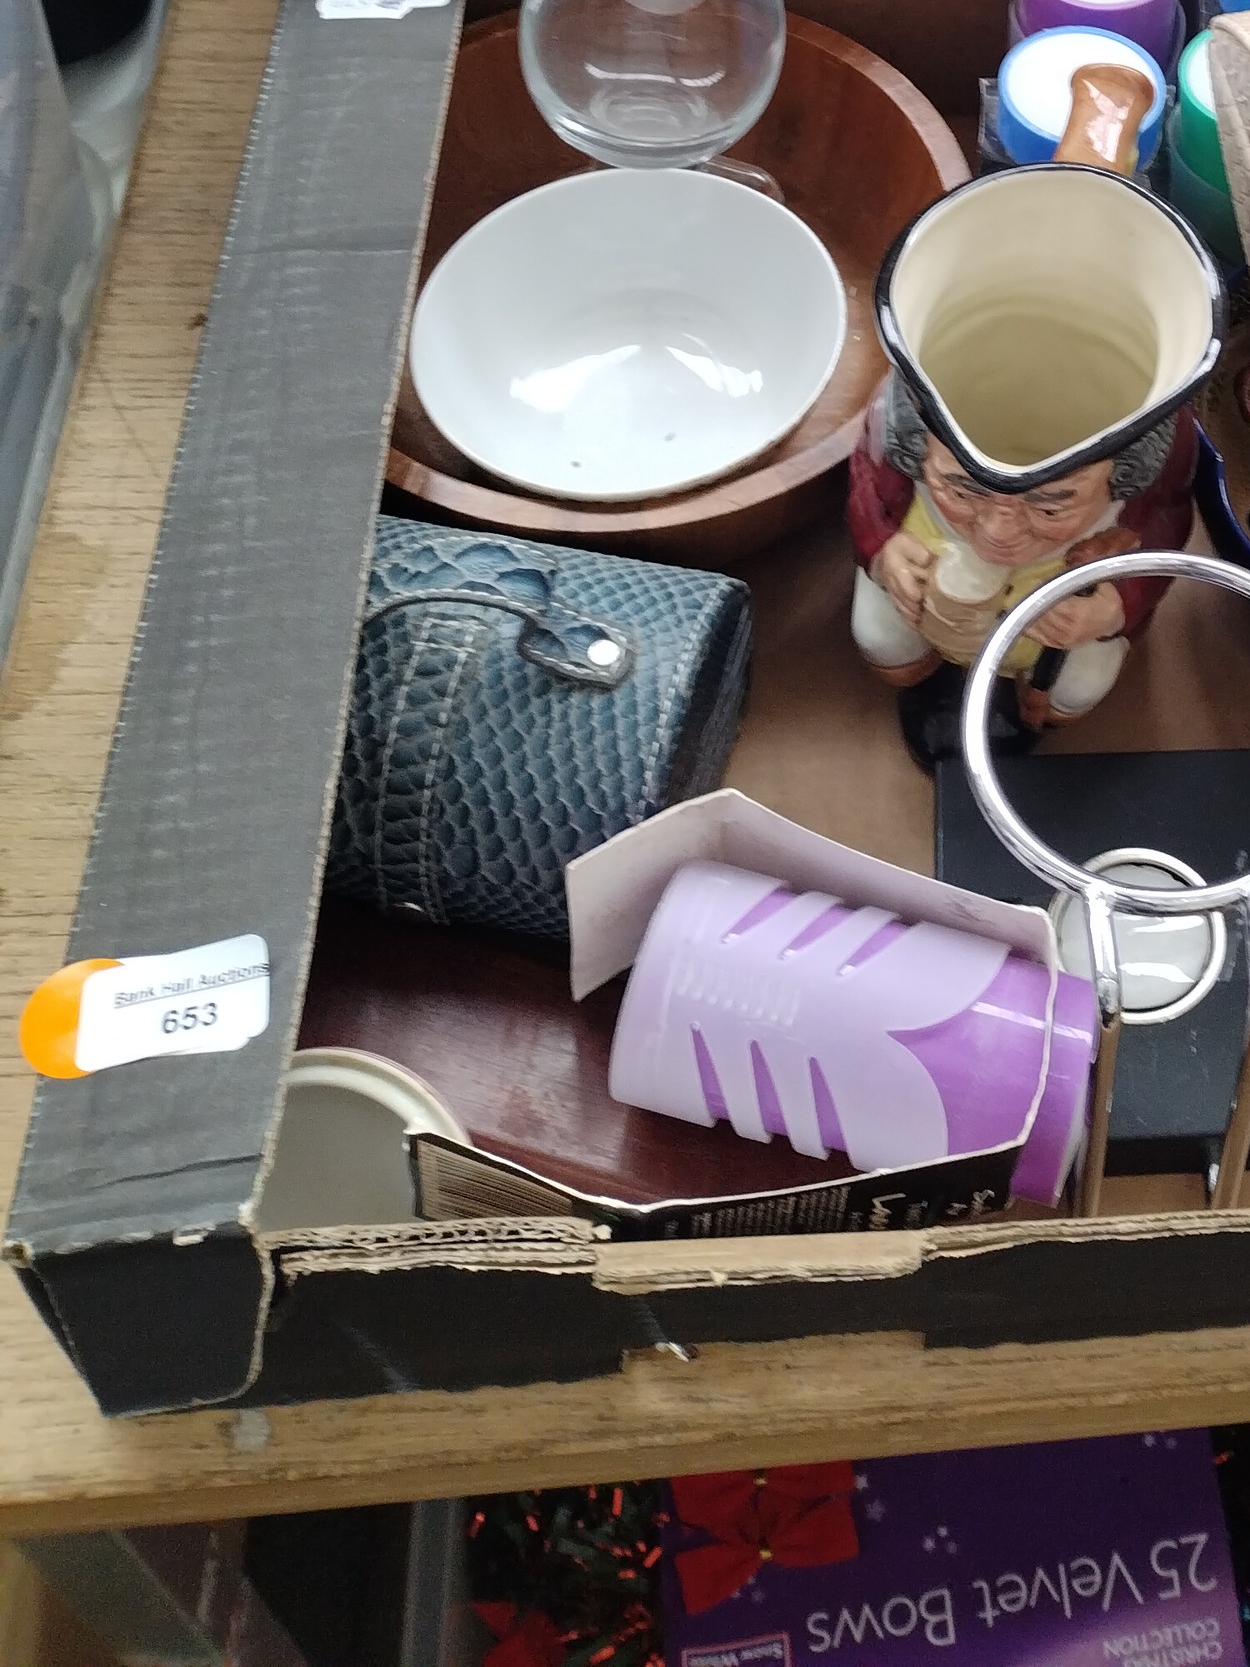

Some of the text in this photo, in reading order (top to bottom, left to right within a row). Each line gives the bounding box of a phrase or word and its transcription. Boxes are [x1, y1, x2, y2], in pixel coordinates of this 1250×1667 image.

[161, 977, 194, 993] Hall
[199, 962, 270, 987] Auctions
[162, 1002, 218, 1034] 653
[806, 1531, 1219, 1653] 25 Velvet Bows
[1102, 1618, 1221, 1660] COLLECTION
